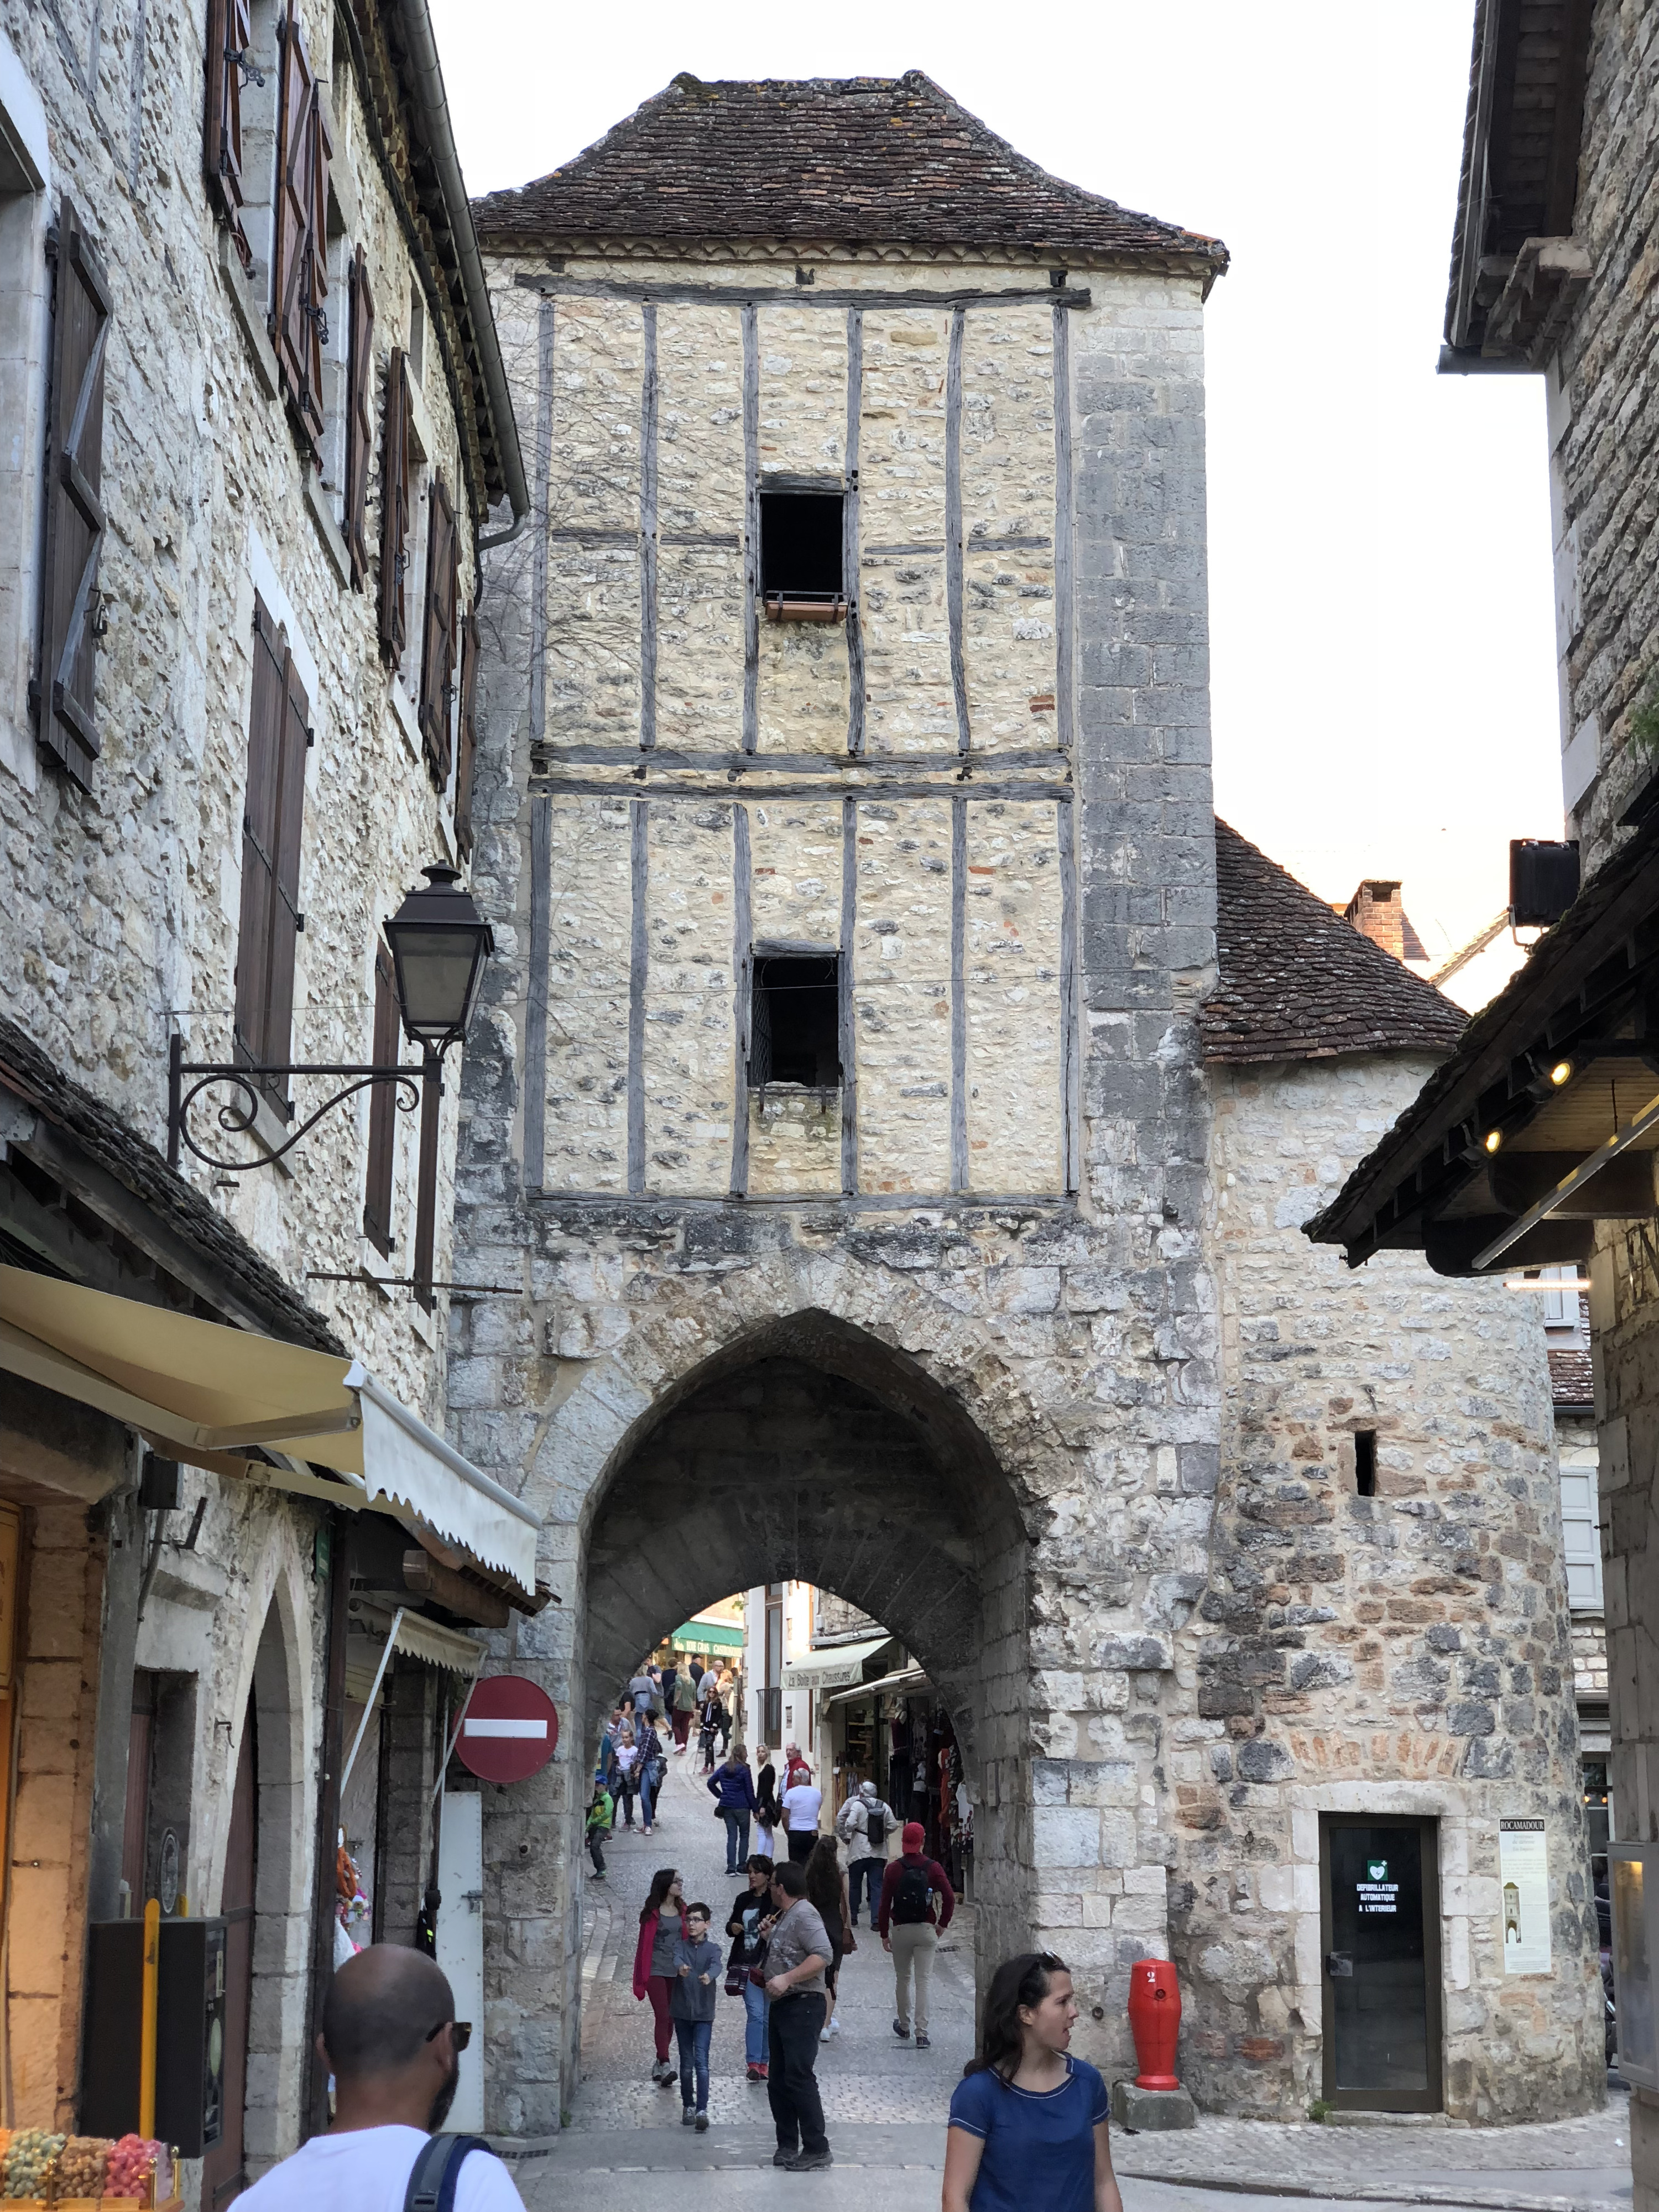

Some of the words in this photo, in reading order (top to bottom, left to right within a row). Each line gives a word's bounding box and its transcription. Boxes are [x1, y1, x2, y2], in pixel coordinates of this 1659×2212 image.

[789, 1674, 795, 1687] La
[811, 1675, 820, 1686] aux
[822, 1671, 850, 1684] Chaussures
[1500, 1821, 1543, 1829] ROCAMADOUR
[1360, 1893, 1395, 1902] AUTOMATIQUE
[1146, 1971, 1156, 1983] 2
